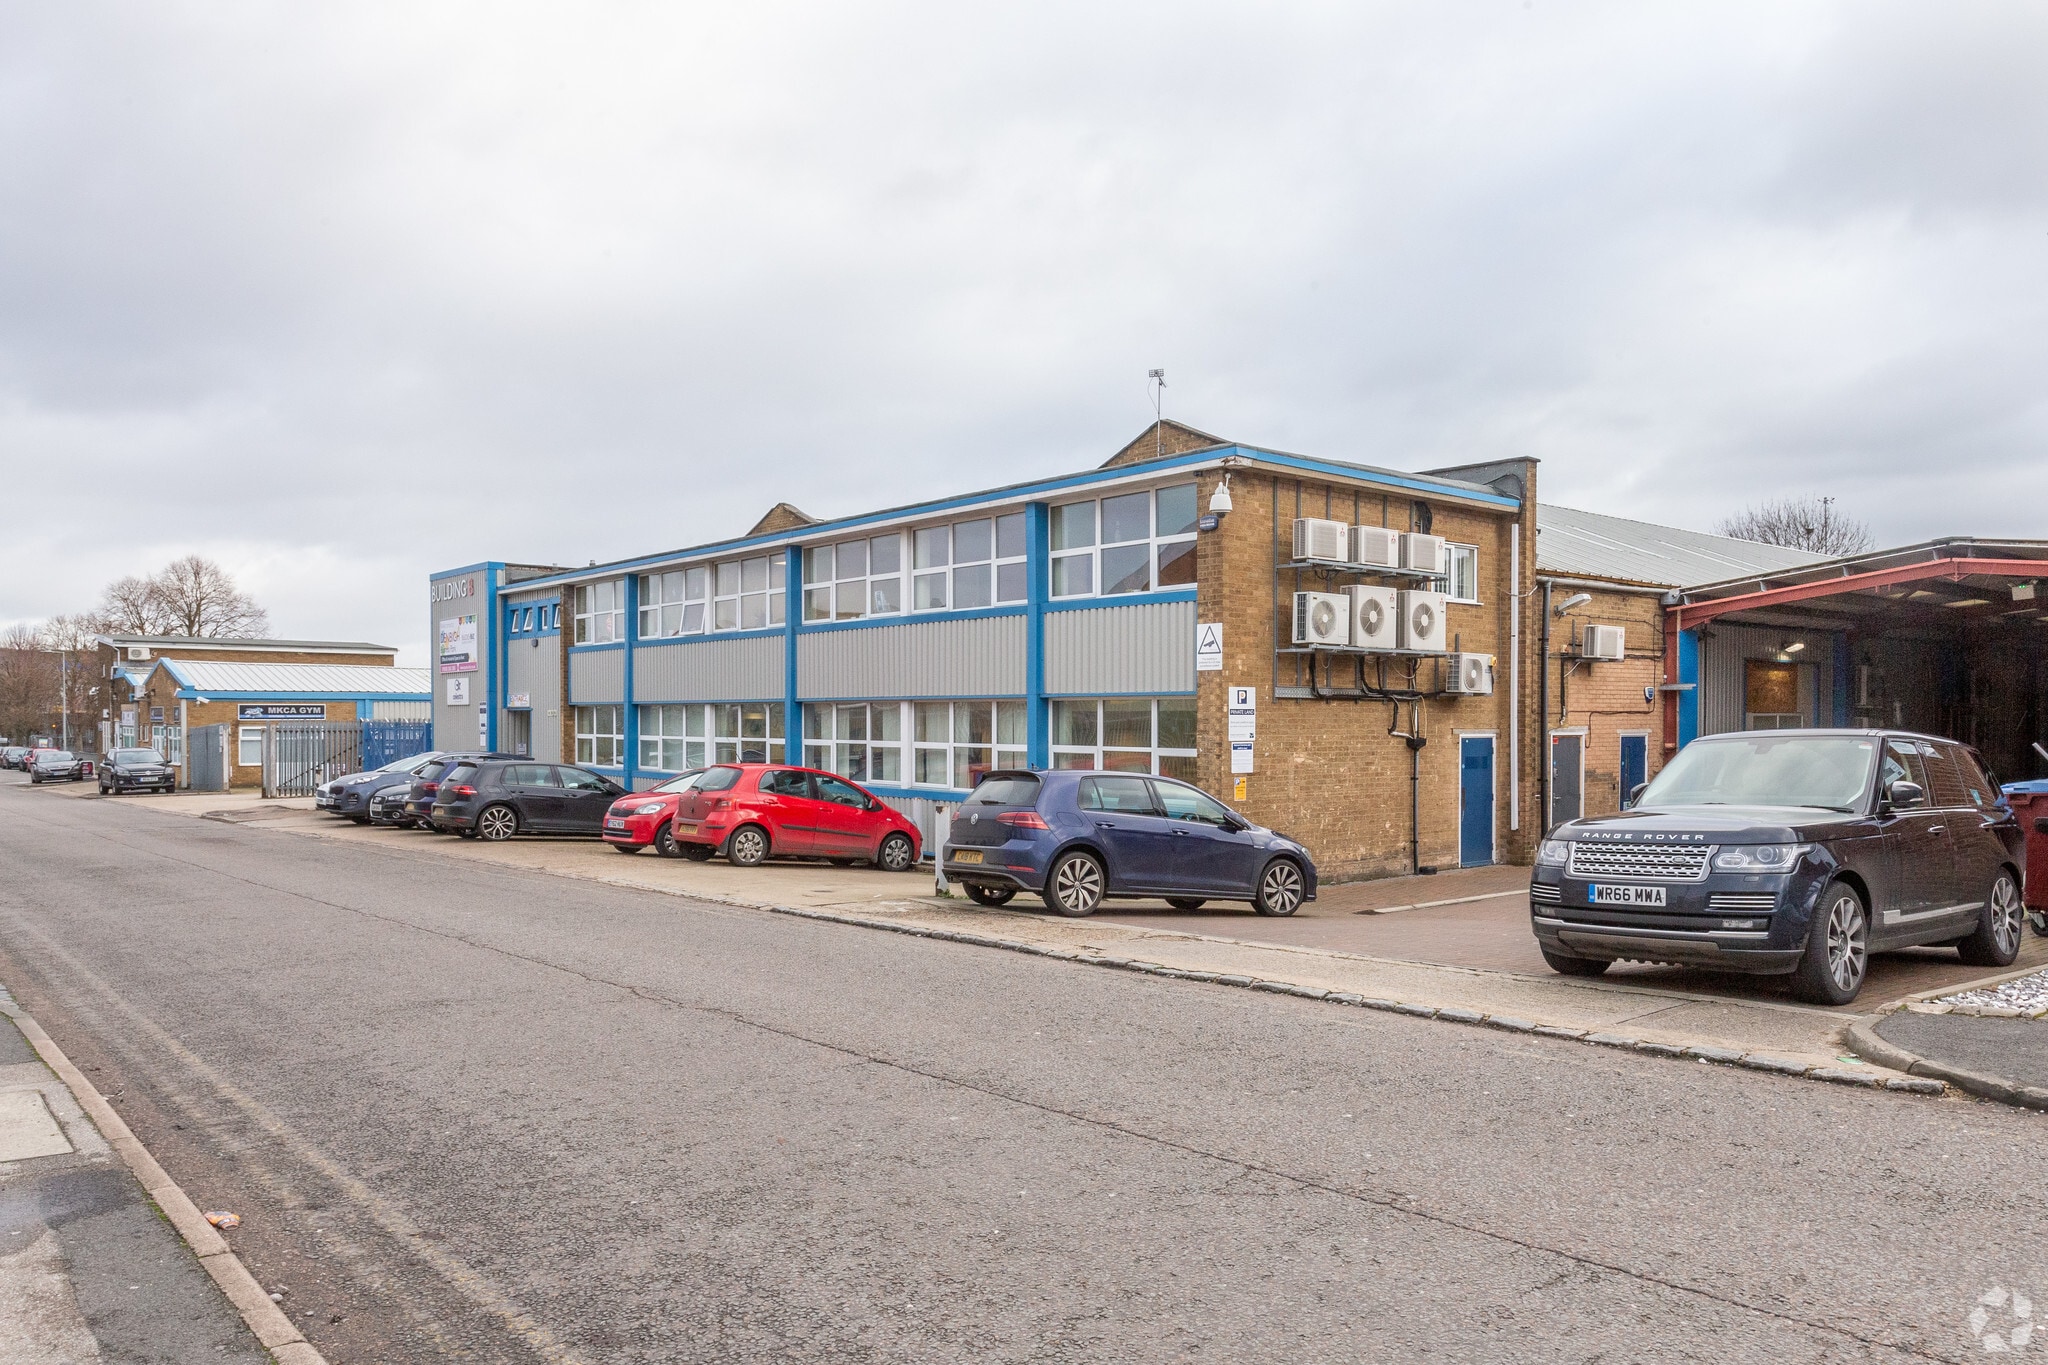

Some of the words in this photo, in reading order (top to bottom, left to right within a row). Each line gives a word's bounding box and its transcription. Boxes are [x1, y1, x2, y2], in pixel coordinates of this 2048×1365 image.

[432, 580, 467, 602] BULDING
[1582, 832, 1633, 840] RANGE
[1596, 886, 1631, 902] WR66
[1634, 887, 1663, 904] MWA
